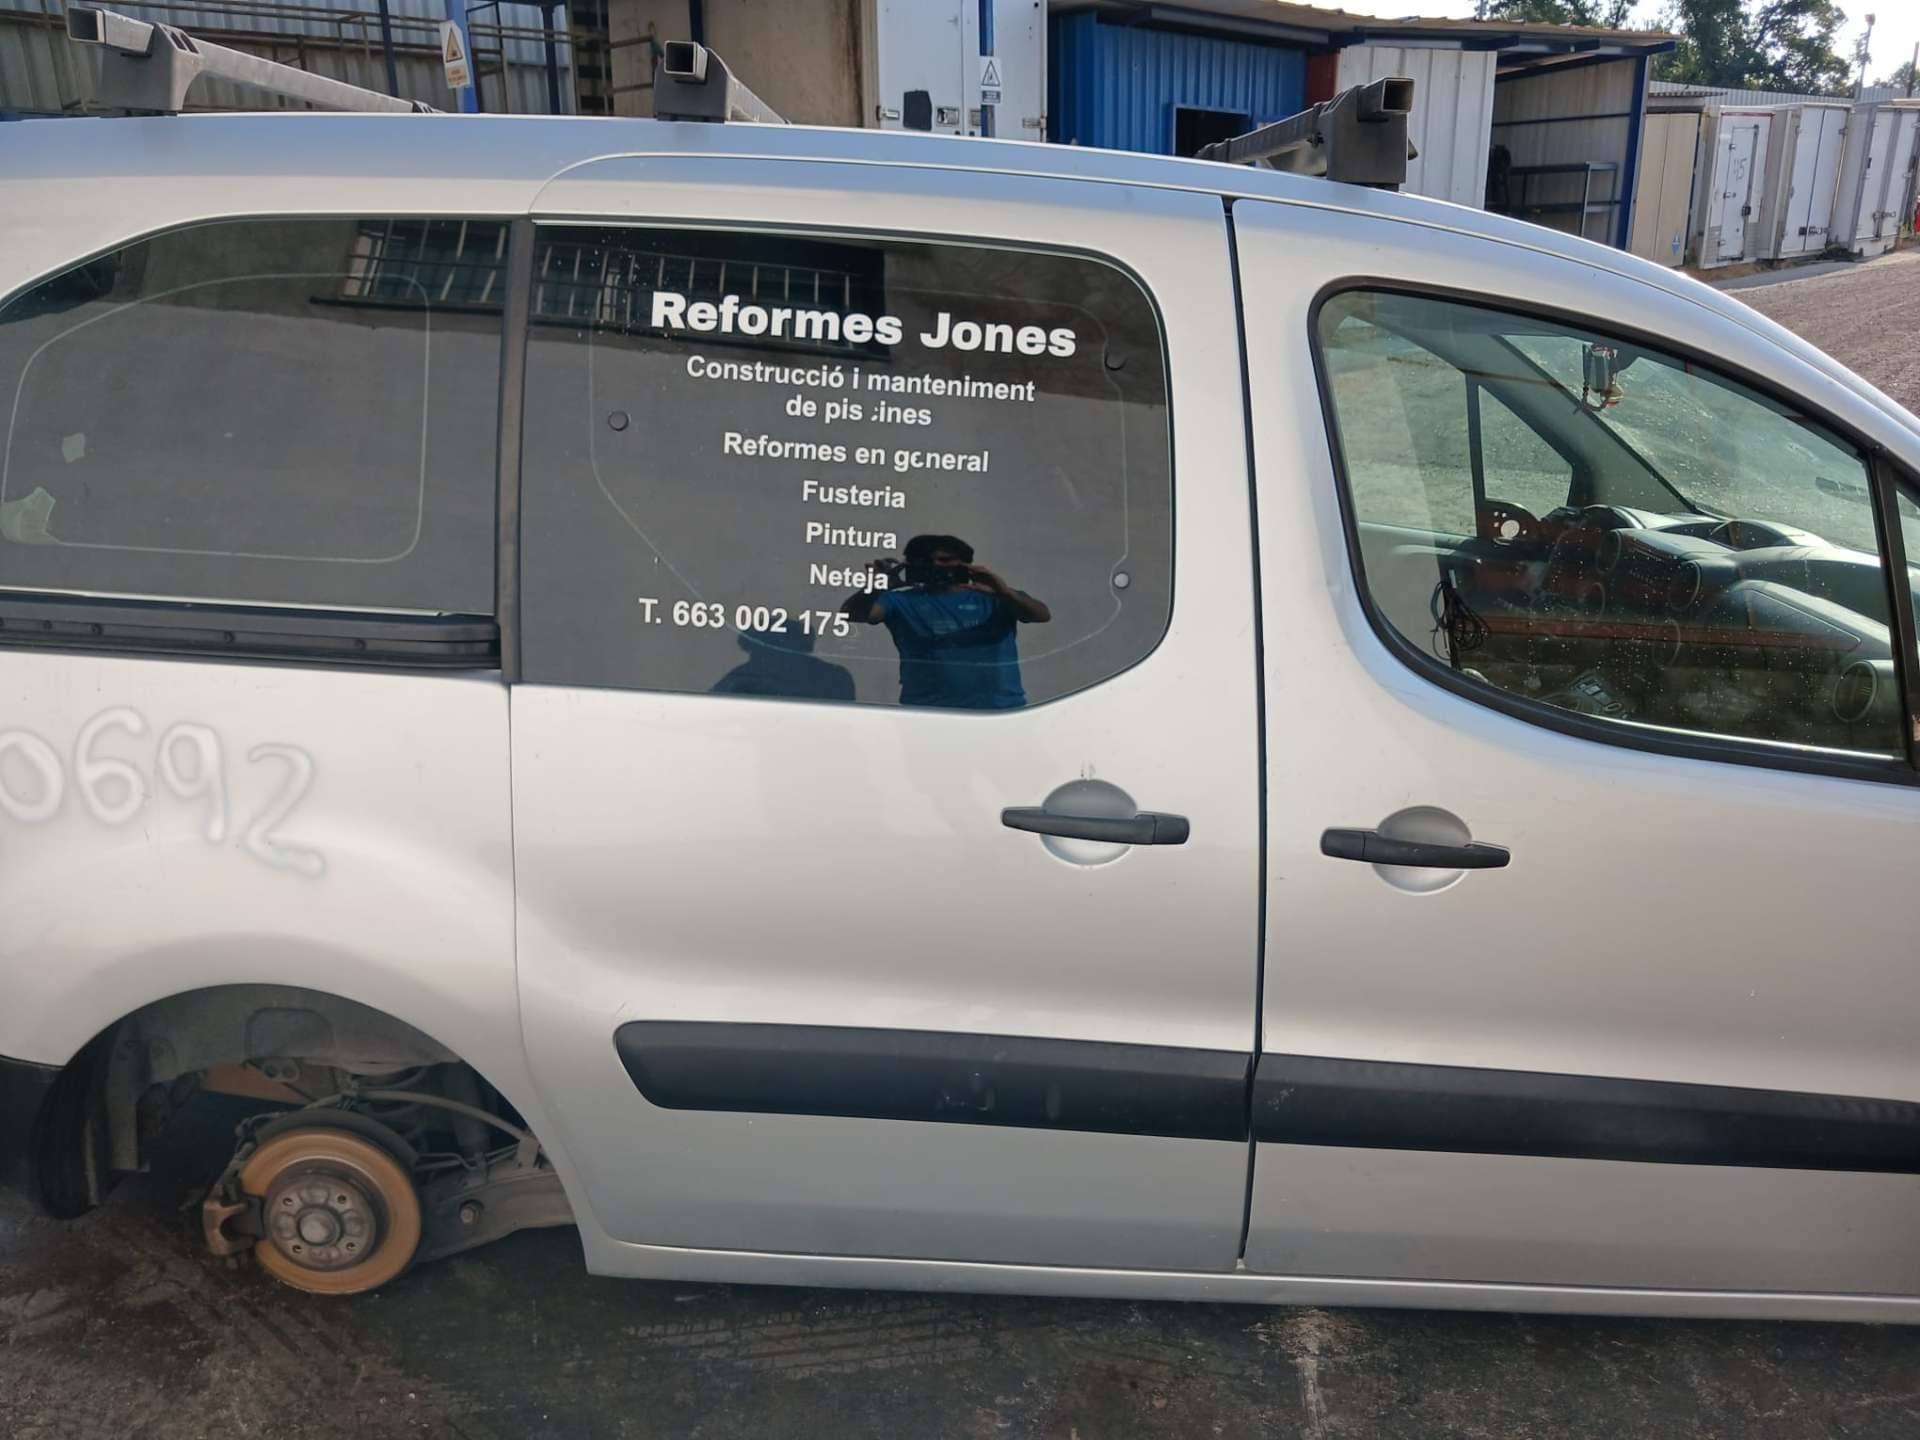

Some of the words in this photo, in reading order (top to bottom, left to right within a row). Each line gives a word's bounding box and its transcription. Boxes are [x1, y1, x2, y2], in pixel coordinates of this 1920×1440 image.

[651, 291, 903, 344] Reformes
[920, 312, 1076, 357] Jones
[687, 355, 845, 389] Construcció
[852, 368, 860, 390] i
[867, 373, 1035, 402] manteniment
[785, 394, 817, 418] de
[724, 432, 847, 463] Reformes
[856, 445, 886, 466] en
[802, 480, 906, 508] Fusteria
[806, 523, 897, 550] Pintura
[810, 564, 889, 594] Neteja
[639, 598, 662, 624] T.
[672, 601, 726, 629] 663
[735, 605, 787, 634] 002
[798, 610, 850, 637] 175
